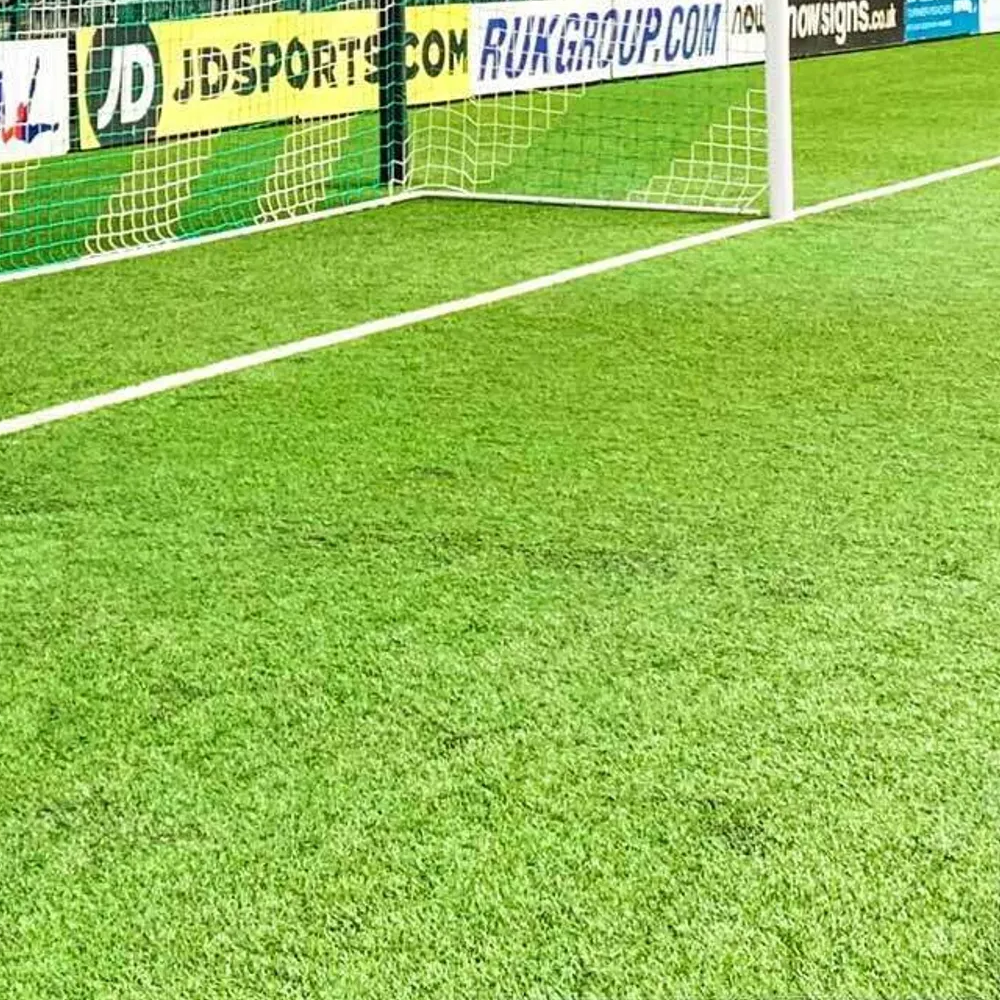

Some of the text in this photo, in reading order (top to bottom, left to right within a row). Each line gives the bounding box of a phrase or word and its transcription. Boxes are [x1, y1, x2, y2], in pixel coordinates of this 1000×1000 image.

[173, 29, 468, 105] JDSPORTSCOM
[477, 3, 722, 82] RUKGROUP.COM
[98, 42, 156, 131] JD
